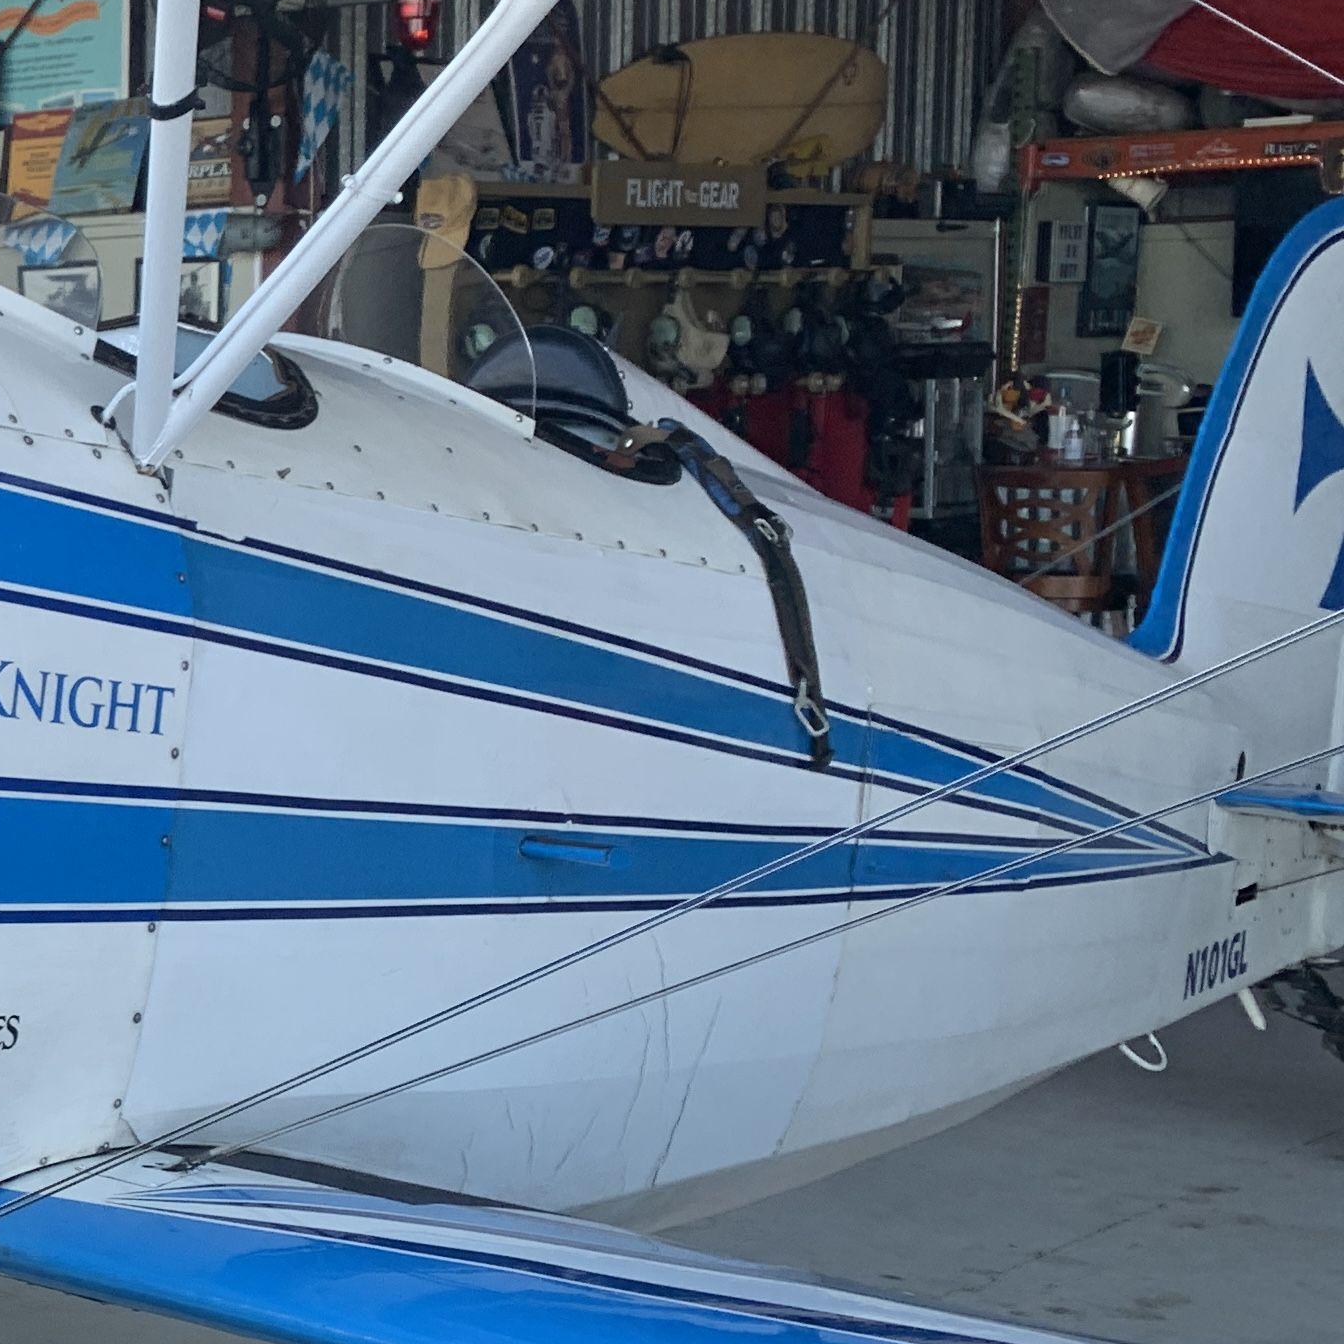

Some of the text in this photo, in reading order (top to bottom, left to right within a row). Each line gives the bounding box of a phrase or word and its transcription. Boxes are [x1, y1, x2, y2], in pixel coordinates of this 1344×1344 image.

[626, 177, 740, 209] FLIGHT GEAR
[1183, 929, 1248, 1001] N101GL
